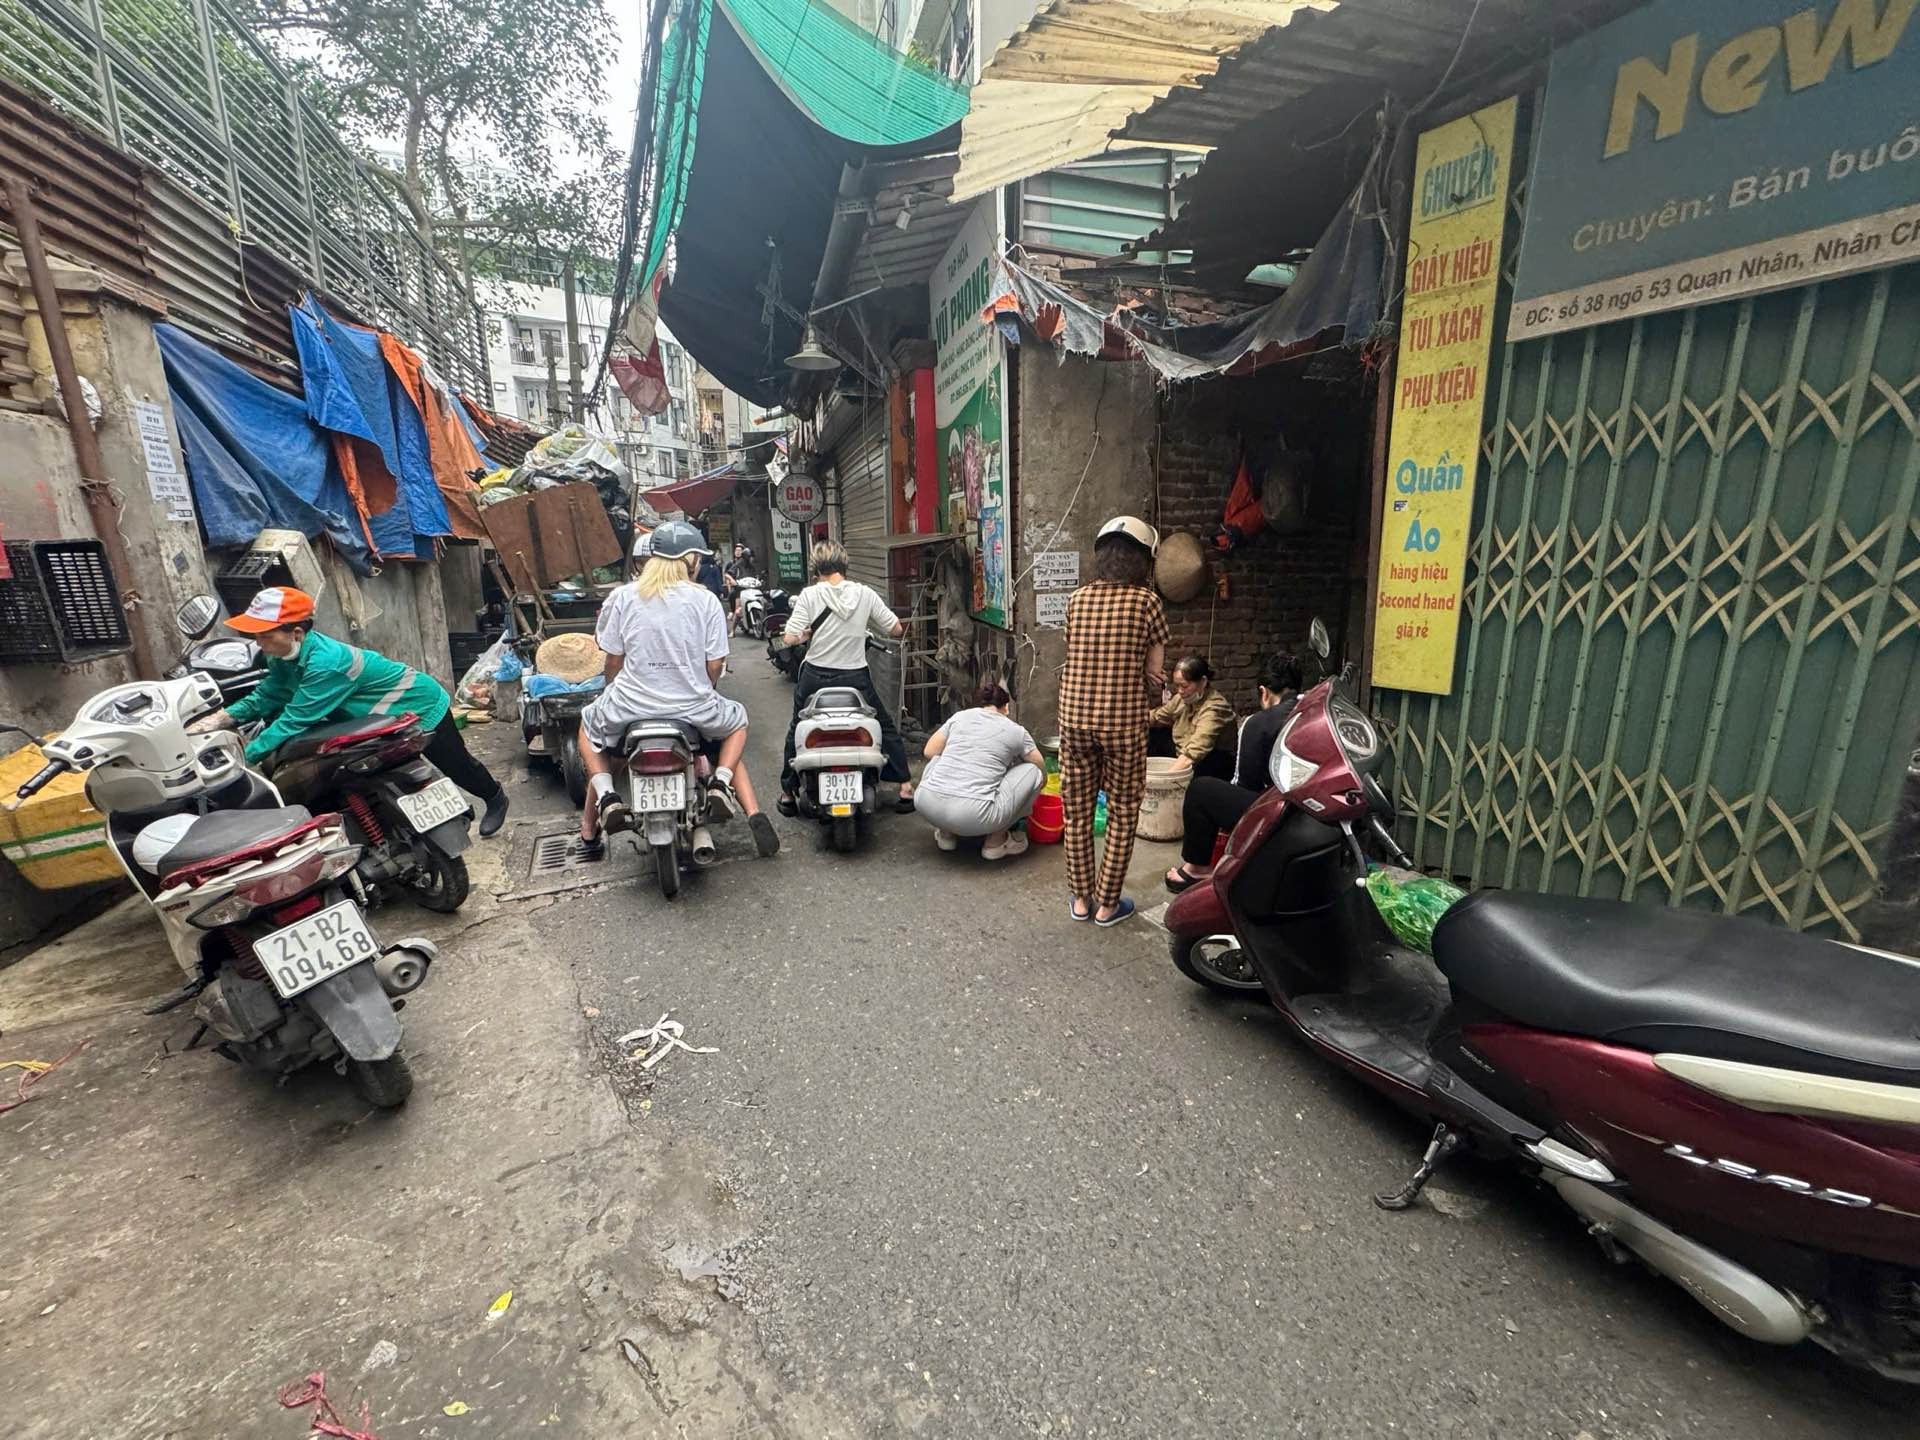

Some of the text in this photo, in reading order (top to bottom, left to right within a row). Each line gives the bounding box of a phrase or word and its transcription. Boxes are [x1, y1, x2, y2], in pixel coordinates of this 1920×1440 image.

[1572, 194, 1716, 251] Chuyên:
[1727, 167, 1810, 209] Bán
[950, 256, 990, 337] PHONG
[1525, 306, 1555, 327] ĐC:
[1558, 294, 1579, 319] số
[1583, 294, 1603, 315] 38
[1608, 286, 1644, 310] ngõ
[1649, 278, 1671, 300] 53
[1677, 268, 1732, 293] Quan
[1738, 252, 1804, 280] Nhân,
[1813, 232, 1882, 264] Nhân
[1408, 303, 1484, 352] TÚI XÁCH
[1400, 361, 1477, 414] PHỤ KIỆN
[1395, 449, 1464, 495] Quần
[1403, 509, 1441, 552] Áo
[1390, 562, 1419, 583] hàng
[1379, 591, 1456, 610] Second hand
[1396, 620, 1414, 640] giá
[640, 775, 678, 794] 29-K1
[640, 792, 678, 810] 6163
[826, 788, 857, 802] 2402
[413, 796, 464, 829] 090.05
[273, 911, 351, 962] 21-B2
[277, 931, 372, 990] 094.68
